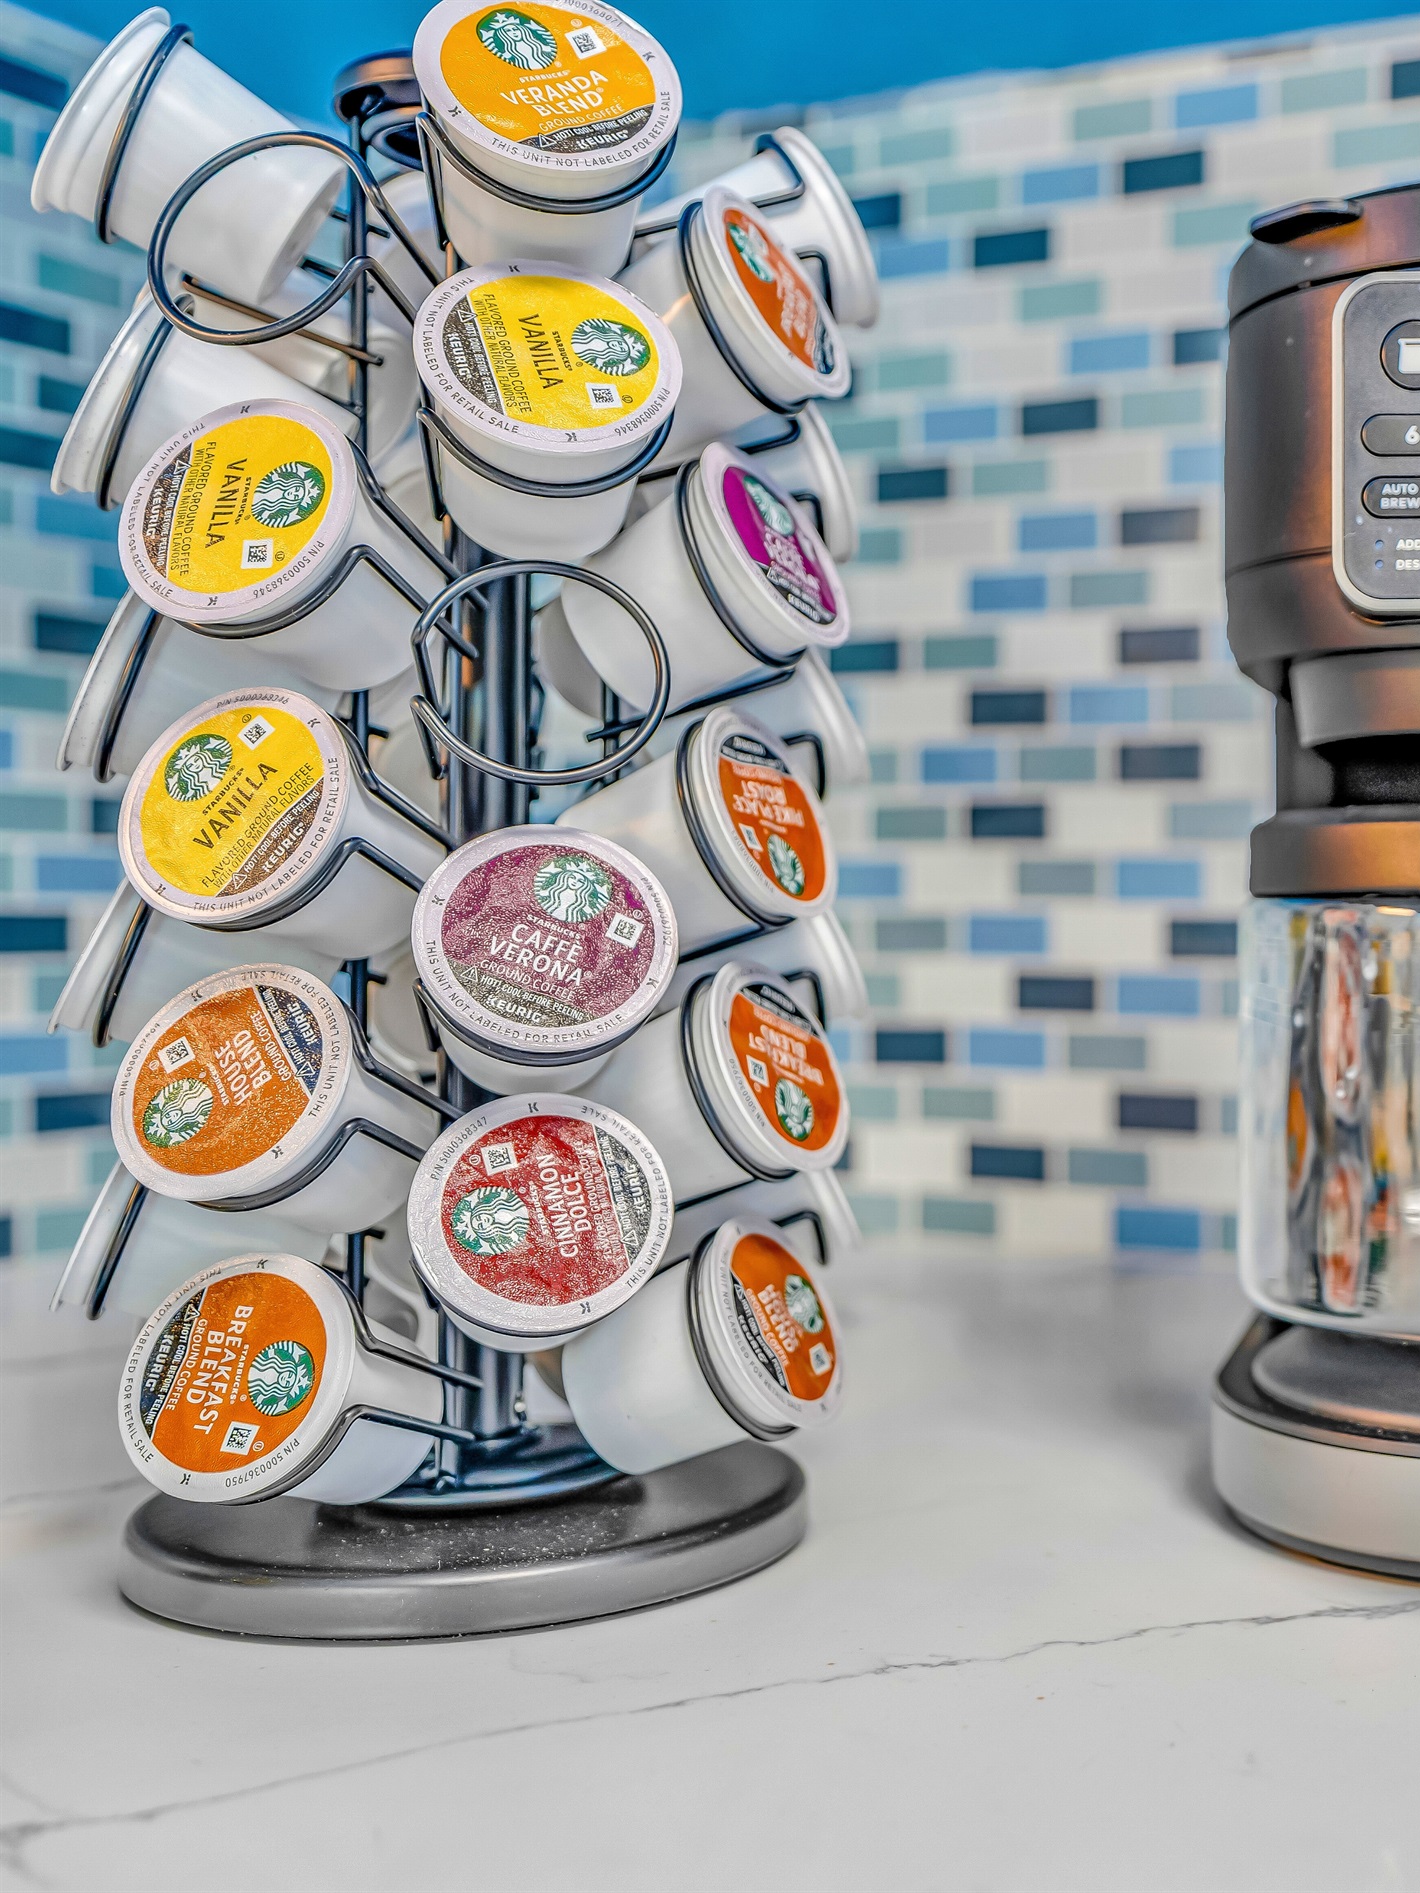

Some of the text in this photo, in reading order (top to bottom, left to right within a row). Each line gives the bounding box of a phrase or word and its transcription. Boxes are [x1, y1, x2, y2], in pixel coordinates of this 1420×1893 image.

[500, 70, 608, 105] VERANDA
[519, 71, 567, 83] STARBUCKS
[531, 90, 603, 117] BLEND
[539, 104, 624, 131] GROUND COFFEE
[619, 110, 649, 126] PEELING
[491, 91, 670, 167] THIS UNIT NOT LABELED FOR RETAIL SALE
[576, 131, 628, 149] KEURIG
[422, 277, 519, 433] THIS UNIT NOT LABELED FOR RETAIL SALE
[447, 333, 467, 378] KEURIG
[479, 317, 517, 408] OTHER NATURAL FLAVORS
[483, 293, 532, 413] FLAVORED GROUND COFFEE
[518, 314, 564, 389] VANILLA
[552, 331, 572, 368] STARBUCKS
[614, 400, 663, 436] 5000368346
[1404, 425, 1420, 445] 6
[128, 422, 205, 597] THIS UNIT LABELED RETAIL SALE
[146, 486, 166, 537] KEURIG
[179, 441, 217, 576] FLAVORED GROUND COFFEE
[205, 458, 247, 548] VANILLA
[235, 476, 251, 525] STARBUCKS
[1380, 498, 1420, 509] BREW
[1382, 483, 1419, 495] AUTO
[170, 469, 199, 571] OTHER NATURAL FLAVORS
[253, 541, 324, 598] P/N 5000368346
[193, 762, 278, 849] VANILLA
[202, 770, 242, 815] STARBUCKS
[272, 790, 319, 839] BEFORE PEELING
[201, 762, 313, 888] FLAVORED GROUND COFFEE
[231, 774, 315, 870] OTHER NATURAL FLAVORS
[248, 757, 339, 903] NOT LABELED FOR RETAIL SALE
[262, 826, 304, 873] KEURIG
[511, 924, 583, 963] CAFFÈ
[526, 914, 580, 939] STARBUCKS
[479, 960, 575, 999] GROUND COFFEE
[491, 937, 583, 985] VERONA
[426, 940, 624, 1043] THIS UNIT NOT LABELED FOR RETAIL SALE
[486, 995, 542, 1022] KEURIG
[523, 991, 584, 1020] BEFORE PEELING
[250, 1010, 292, 1081] GROUND COFFEE
[287, 1003, 318, 1046] KEURIG
[215, 1041, 253, 1106] HOUSE
[233, 1030, 272, 1089] BLEND
[308, 997, 340, 1118] THIS UNIT NOT LABELED
[581, 1105, 608, 1121] SALE
[430, 1116, 487, 1180] P/N 5000368347
[640, 1147, 657, 1165] FOR
[537, 1153, 579, 1258] CINNAMON
[561, 1171, 591, 1232] DOLCE
[625, 1164, 648, 1213] KEURIG
[653, 1167, 668, 1215] LABELED
[659, 1218, 668, 1238] NOT
[626, 1266, 647, 1289] THIS
[647, 1242, 663, 1265] UNIT
[722, 1290, 732, 1311] NOT
[758, 1289, 799, 1353] BLEND
[746, 1288, 770, 1331] GROUND
[766, 1332, 790, 1368] COFFEE
[123, 1302, 172, 1463] NOT LABELED FOR RETAIL SALE
[145, 1334, 172, 1388] KEURIG
[165, 1318, 208, 1411] GROUND COFFEE
[186, 1330, 226, 1404] BLEND
[193, 1305, 254, 1435] BREAKFAST
[230, 1344, 250, 1400] STARBUCKS
[145, 1364, 177, 1425] BEFORE PEELING
[225, 1438, 300, 1487] P/N 5000367950
